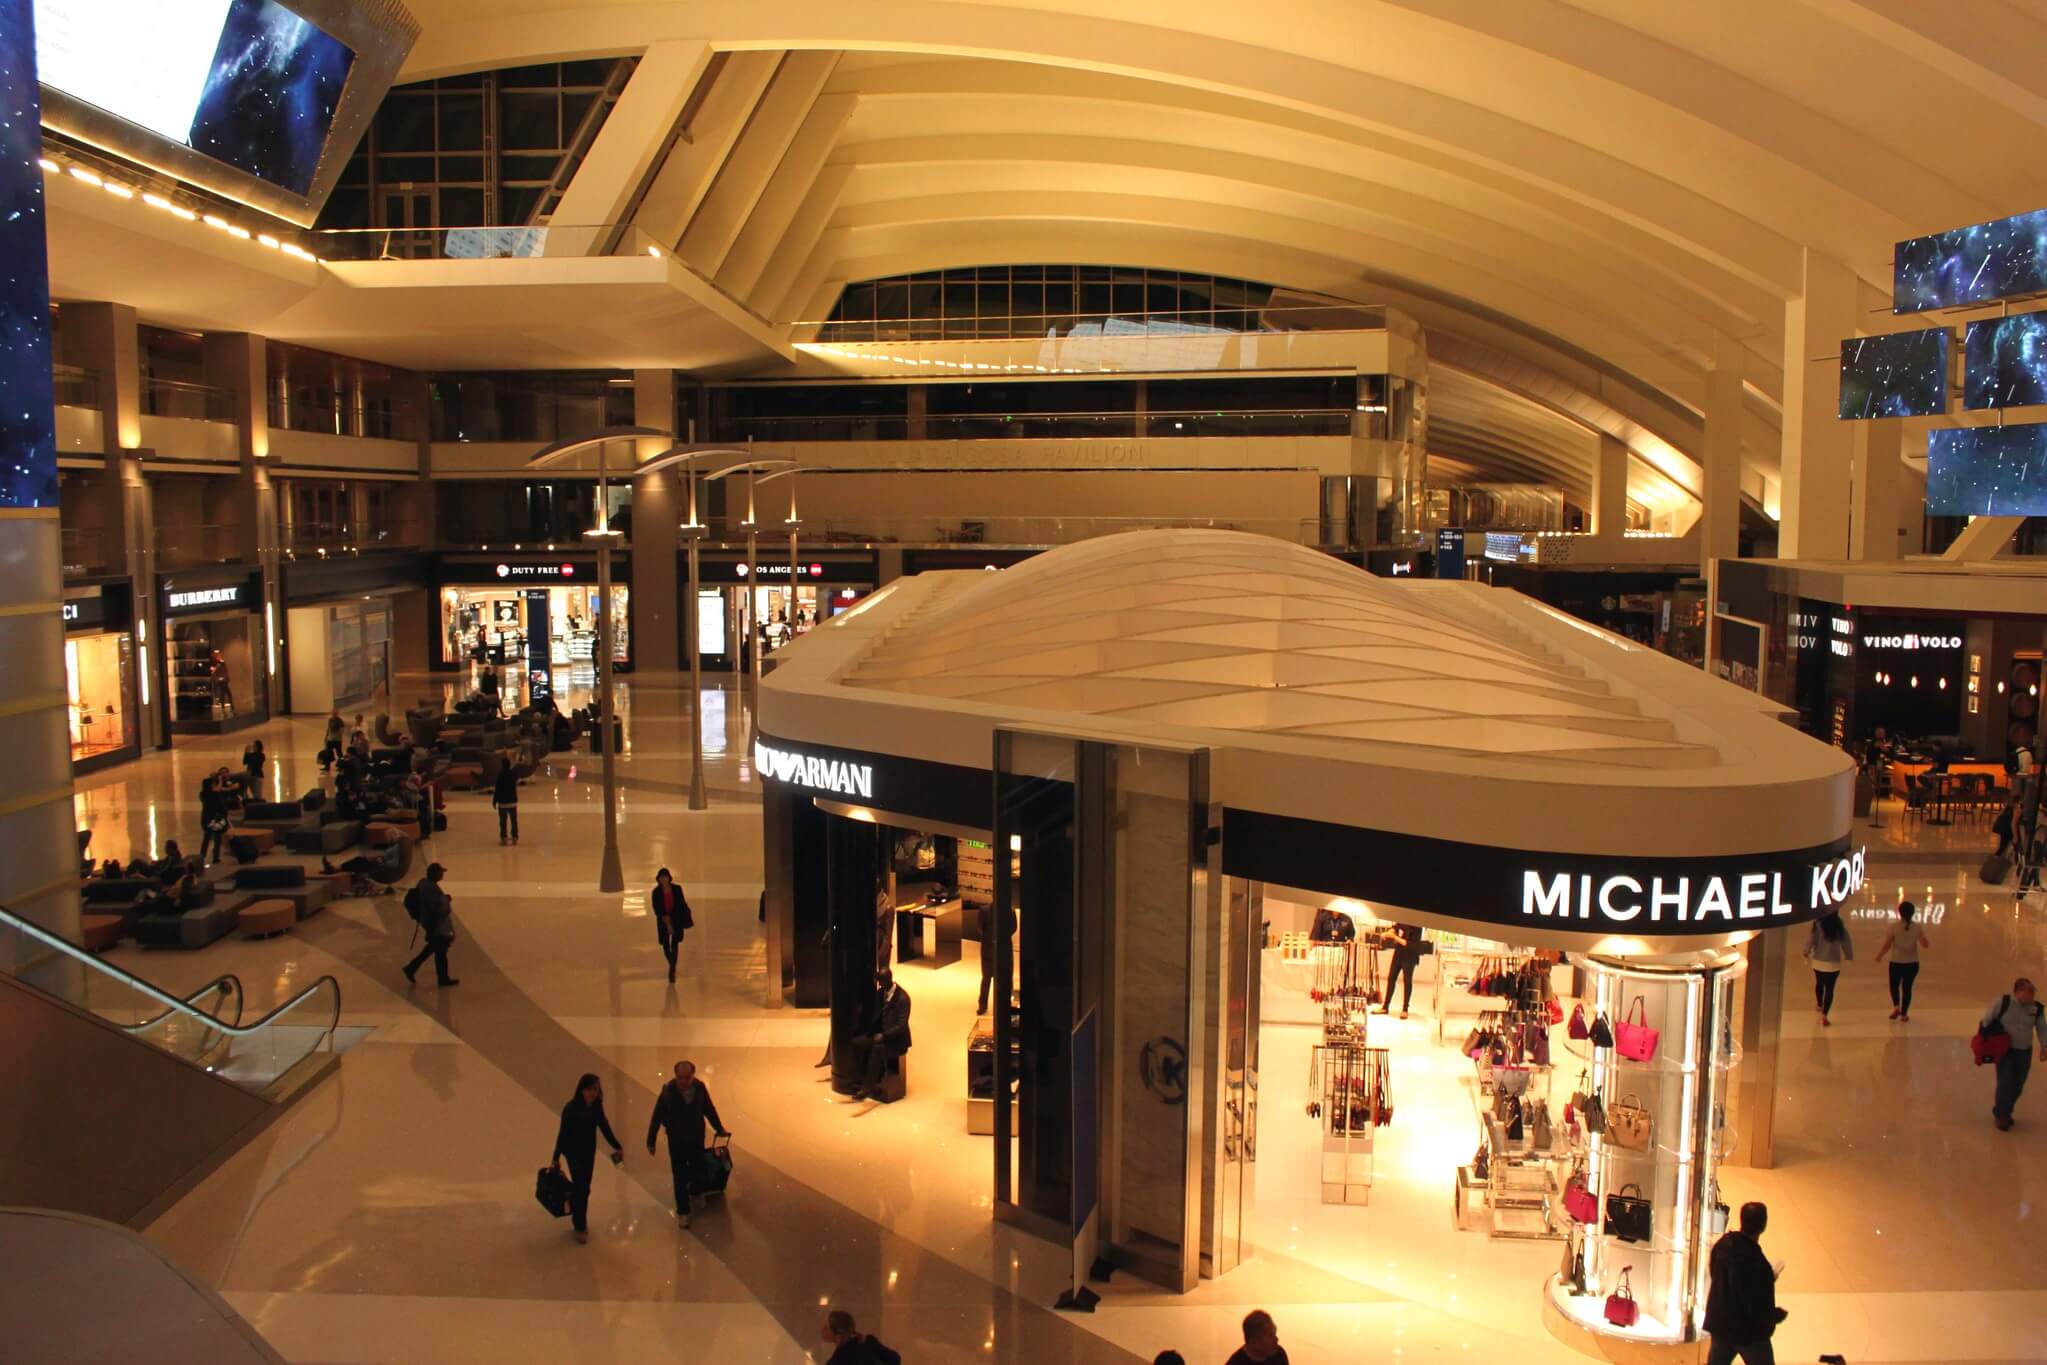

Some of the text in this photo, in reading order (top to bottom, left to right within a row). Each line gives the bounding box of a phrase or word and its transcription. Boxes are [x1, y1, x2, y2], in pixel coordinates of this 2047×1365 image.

[512, 567, 559, 575] DUTY FREE
[769, 566, 807, 574] ANGEES
[169, 587, 238, 608] BURBERRY
[1863, 636, 1962, 649] VINO VOLO
[792, 753, 873, 798] ARMANI
[1523, 870, 1793, 921] MICHAEL
